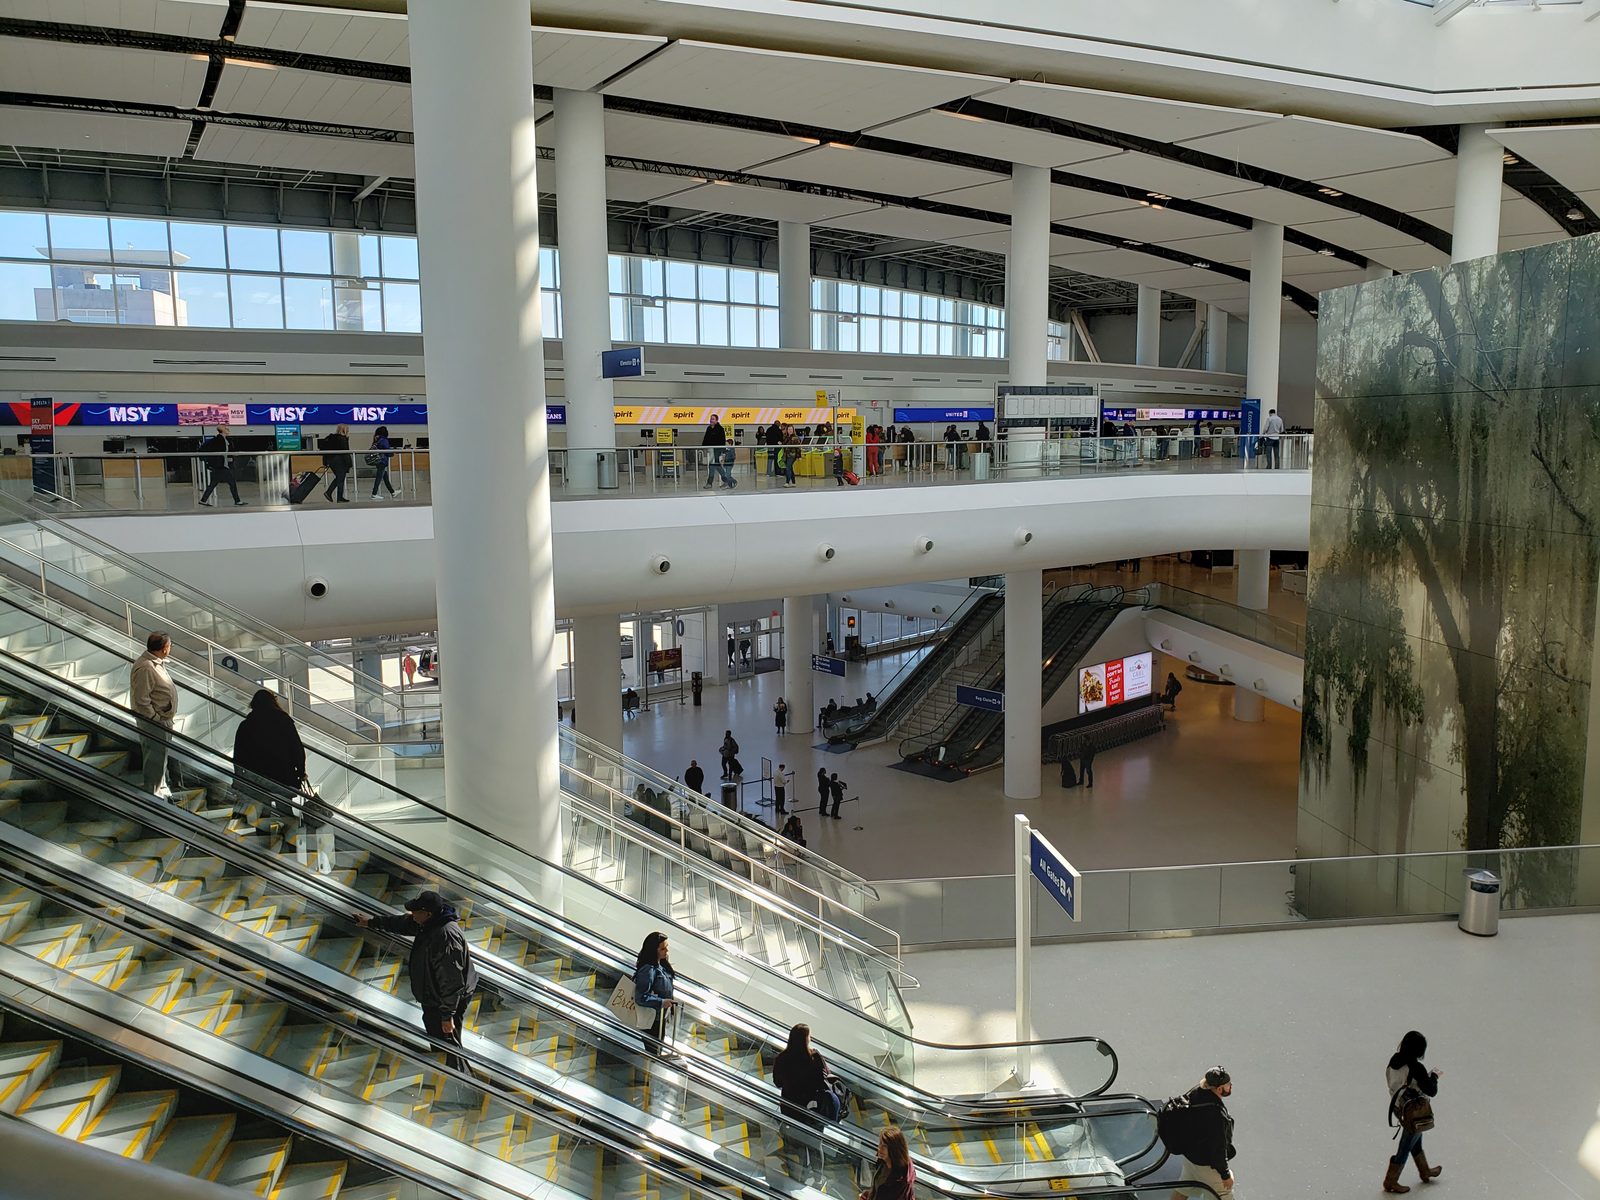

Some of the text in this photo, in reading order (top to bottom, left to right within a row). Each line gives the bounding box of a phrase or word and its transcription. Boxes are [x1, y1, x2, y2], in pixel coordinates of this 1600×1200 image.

[109, 406, 151, 422] MSY
[270, 407, 306, 421] MSY
[353, 407, 387, 421] MSY
[673, 411, 694, 419] spirit
[1047, 866, 1059, 887] Gates
